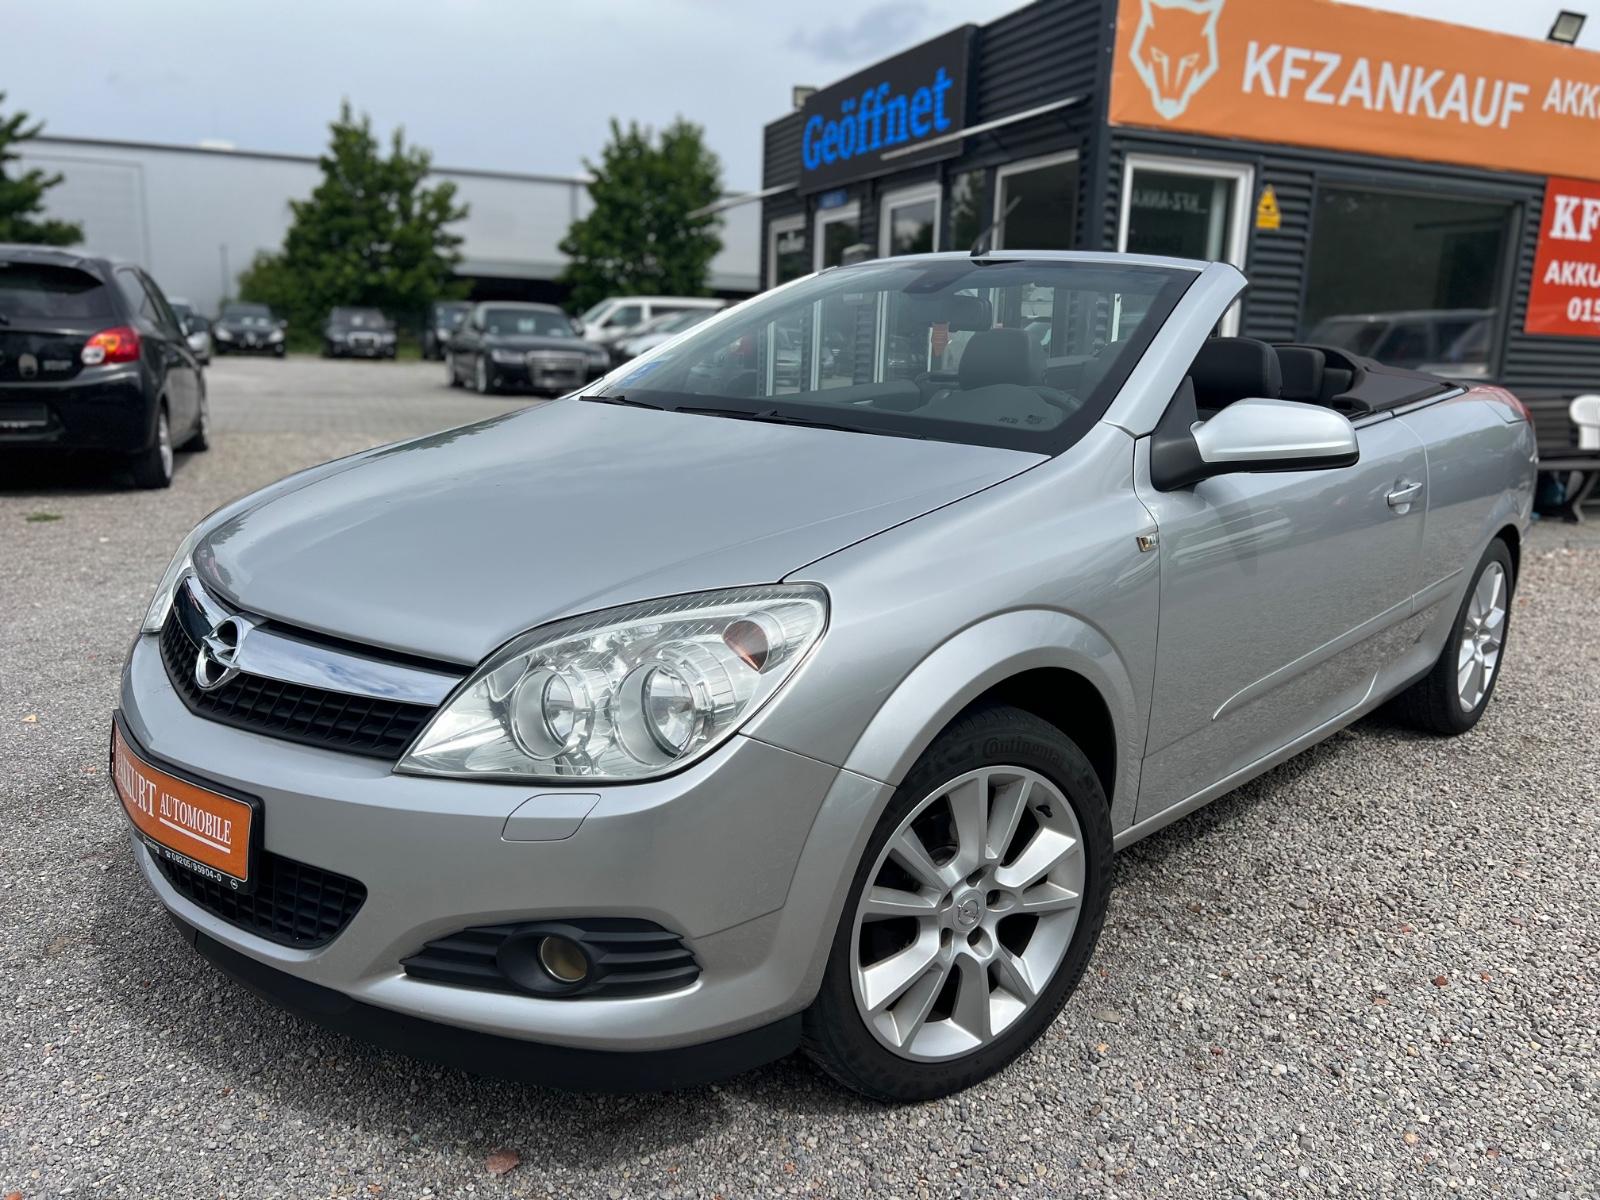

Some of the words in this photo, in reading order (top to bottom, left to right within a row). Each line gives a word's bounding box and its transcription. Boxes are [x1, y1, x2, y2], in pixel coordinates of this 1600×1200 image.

[802, 66, 954, 170] Geöffnet
[1242, 41, 1530, 129] KFZANKAUF
[1541, 77, 1600, 120] AKK
[159, 791, 232, 845] AUTOMOBILE
